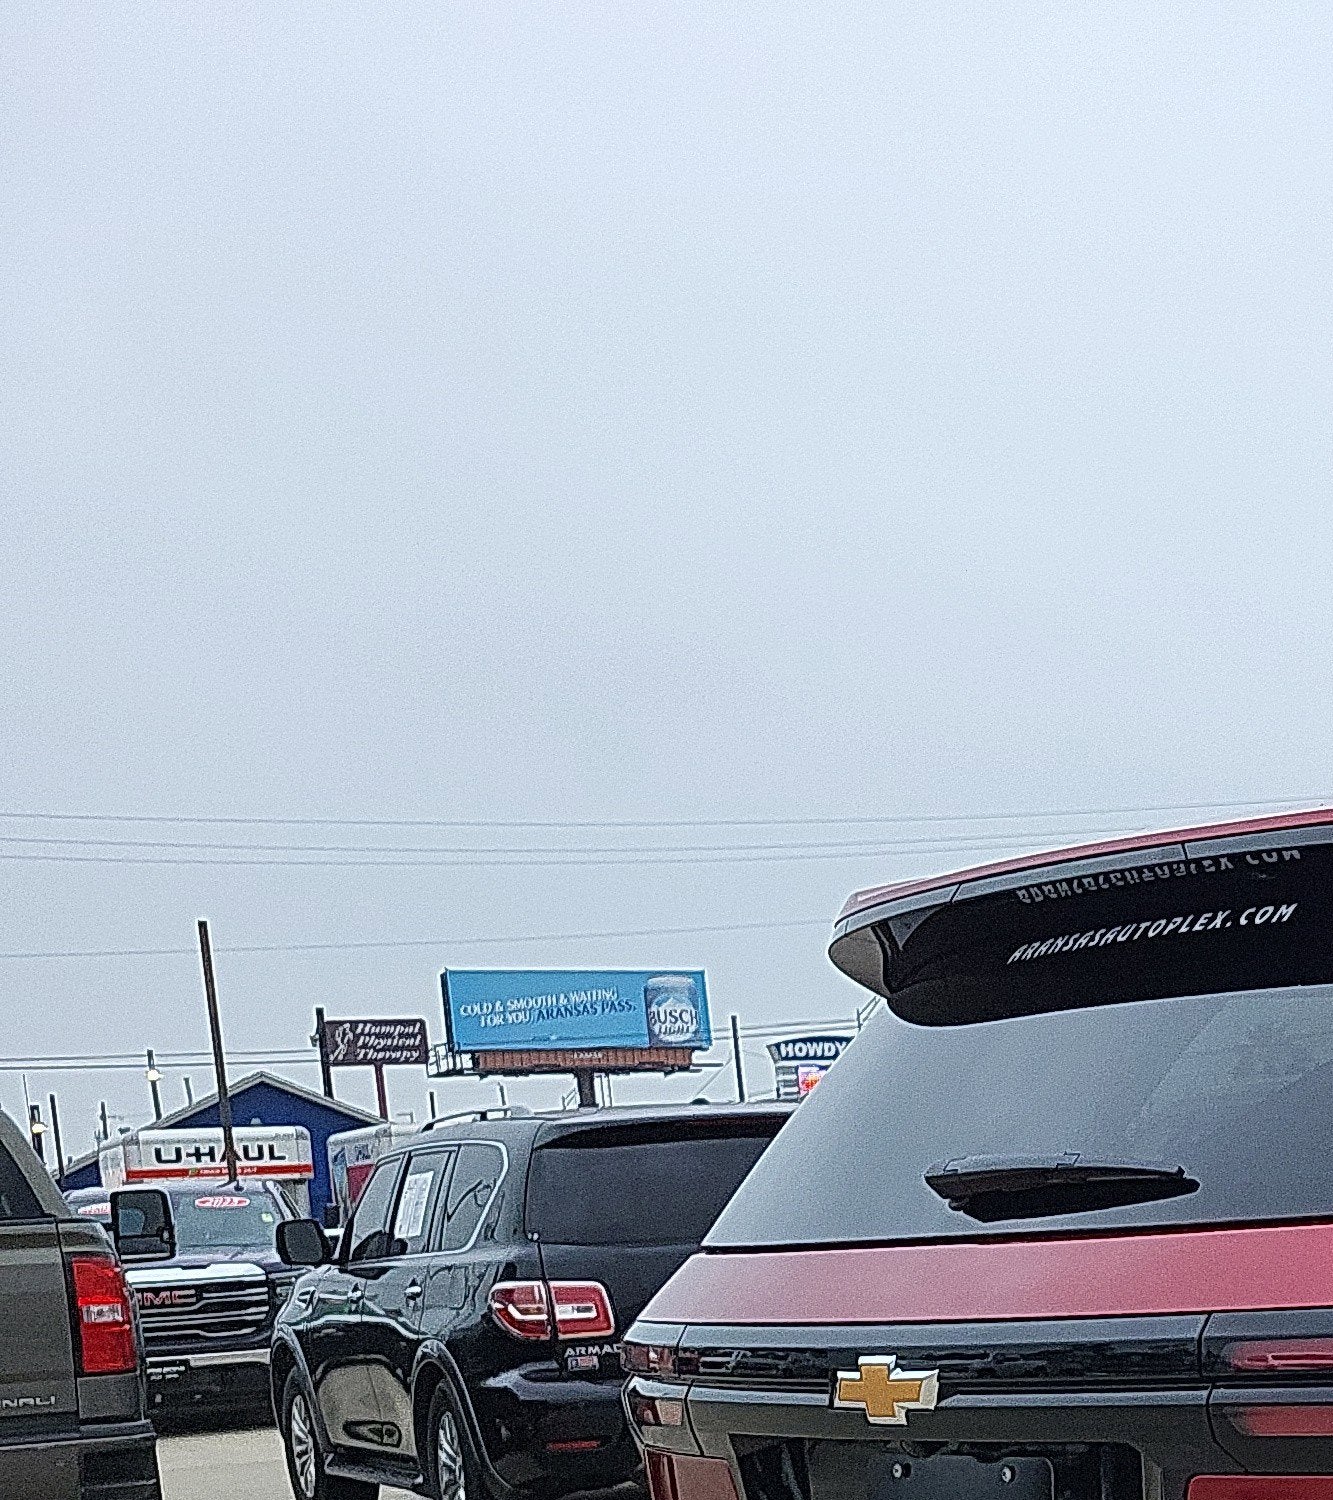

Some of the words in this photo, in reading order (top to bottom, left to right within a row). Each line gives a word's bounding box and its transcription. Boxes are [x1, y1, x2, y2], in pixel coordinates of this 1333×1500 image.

[1006, 903, 1298, 965] ARANSASAUTOPLEX.COM
[506, 994, 558, 1011] SMOOTH
[536, 1002, 598, 1022] ARANSAS
[649, 1009, 699, 1026] BUSCH
[357, 1034, 421, 1050] Physical
[355, 1048, 420, 1062] Therapy
[135, 1289, 197, 1306] MC
[0, 1395, 56, 1409] NALI
